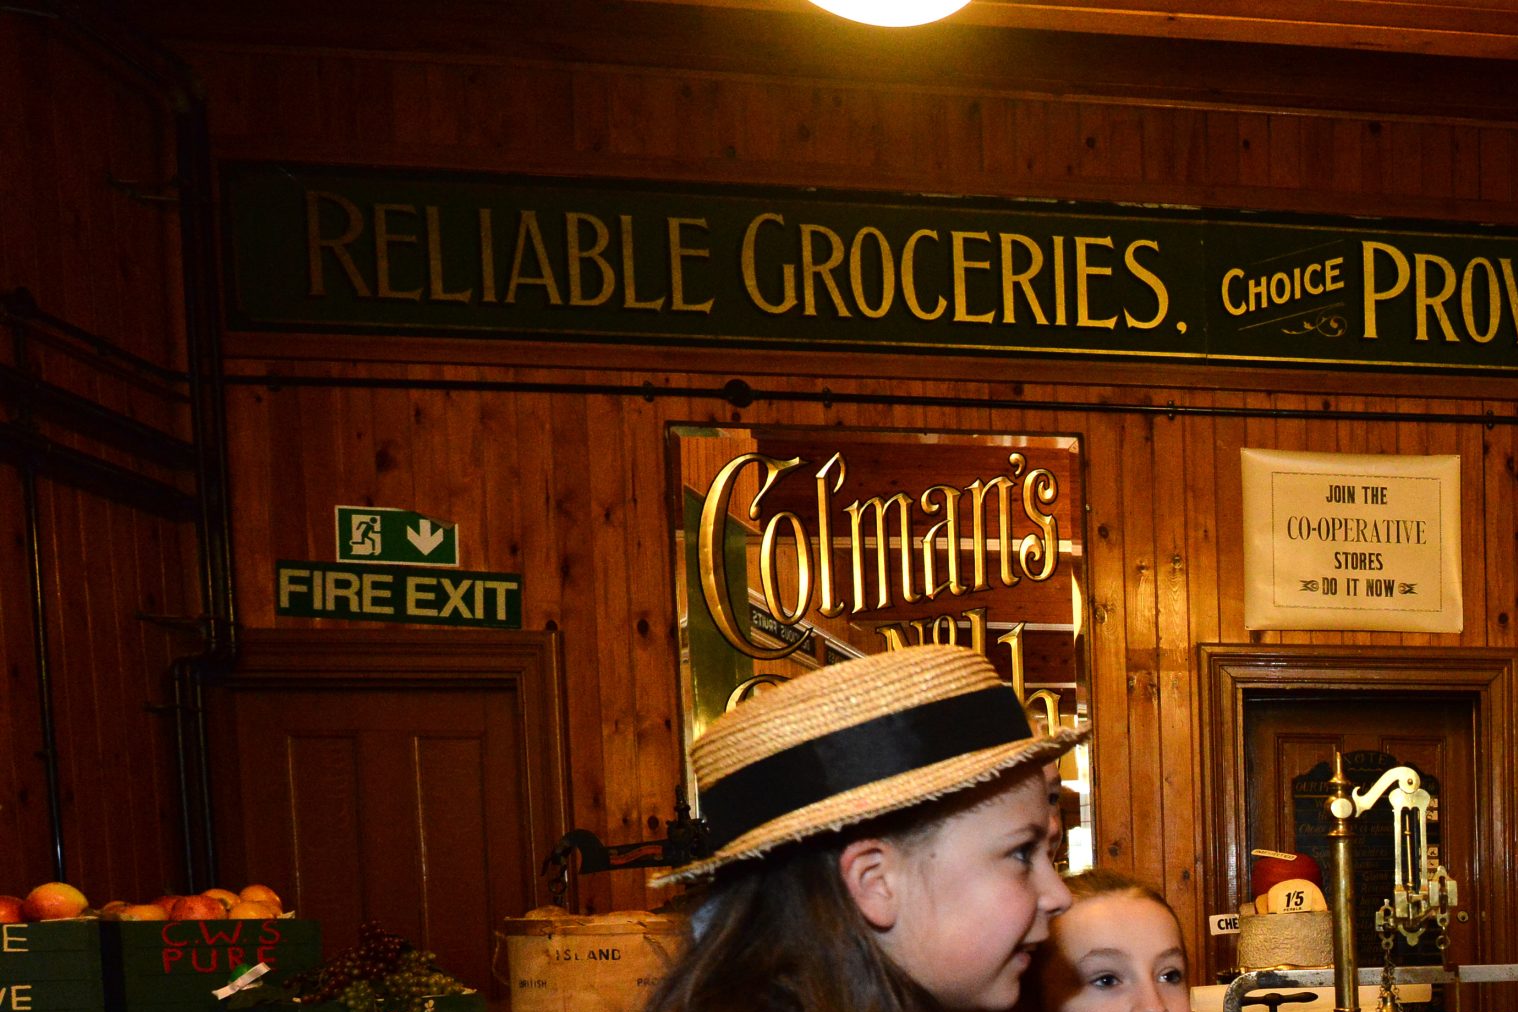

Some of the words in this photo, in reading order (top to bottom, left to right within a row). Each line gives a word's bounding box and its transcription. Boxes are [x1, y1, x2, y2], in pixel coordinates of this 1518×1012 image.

[306, 190, 715, 314] RELIABLE
[740, 211, 1188, 337] GROCERIES,
[1221, 256, 1346, 319] CHOICE
[1325, 485, 1358, 506] JOIN
[1361, 486, 1388, 506] THE
[1287, 515, 1427, 545] CO-OPERATIVE
[699, 451, 1060, 660] Colman's
[1334, 551, 1383, 571] STORES
[279, 568, 395, 615] FIRE
[406, 576, 518, 621] EXIT
[1321, 577, 1340, 596] DO
[1346, 578, 1362, 597] IT
[1366, 578, 1395, 597] NOW
[162, 945, 280, 974] PURE
[556, 948, 621, 961] ISLAND
[519, 979, 547, 988] BRITISH
